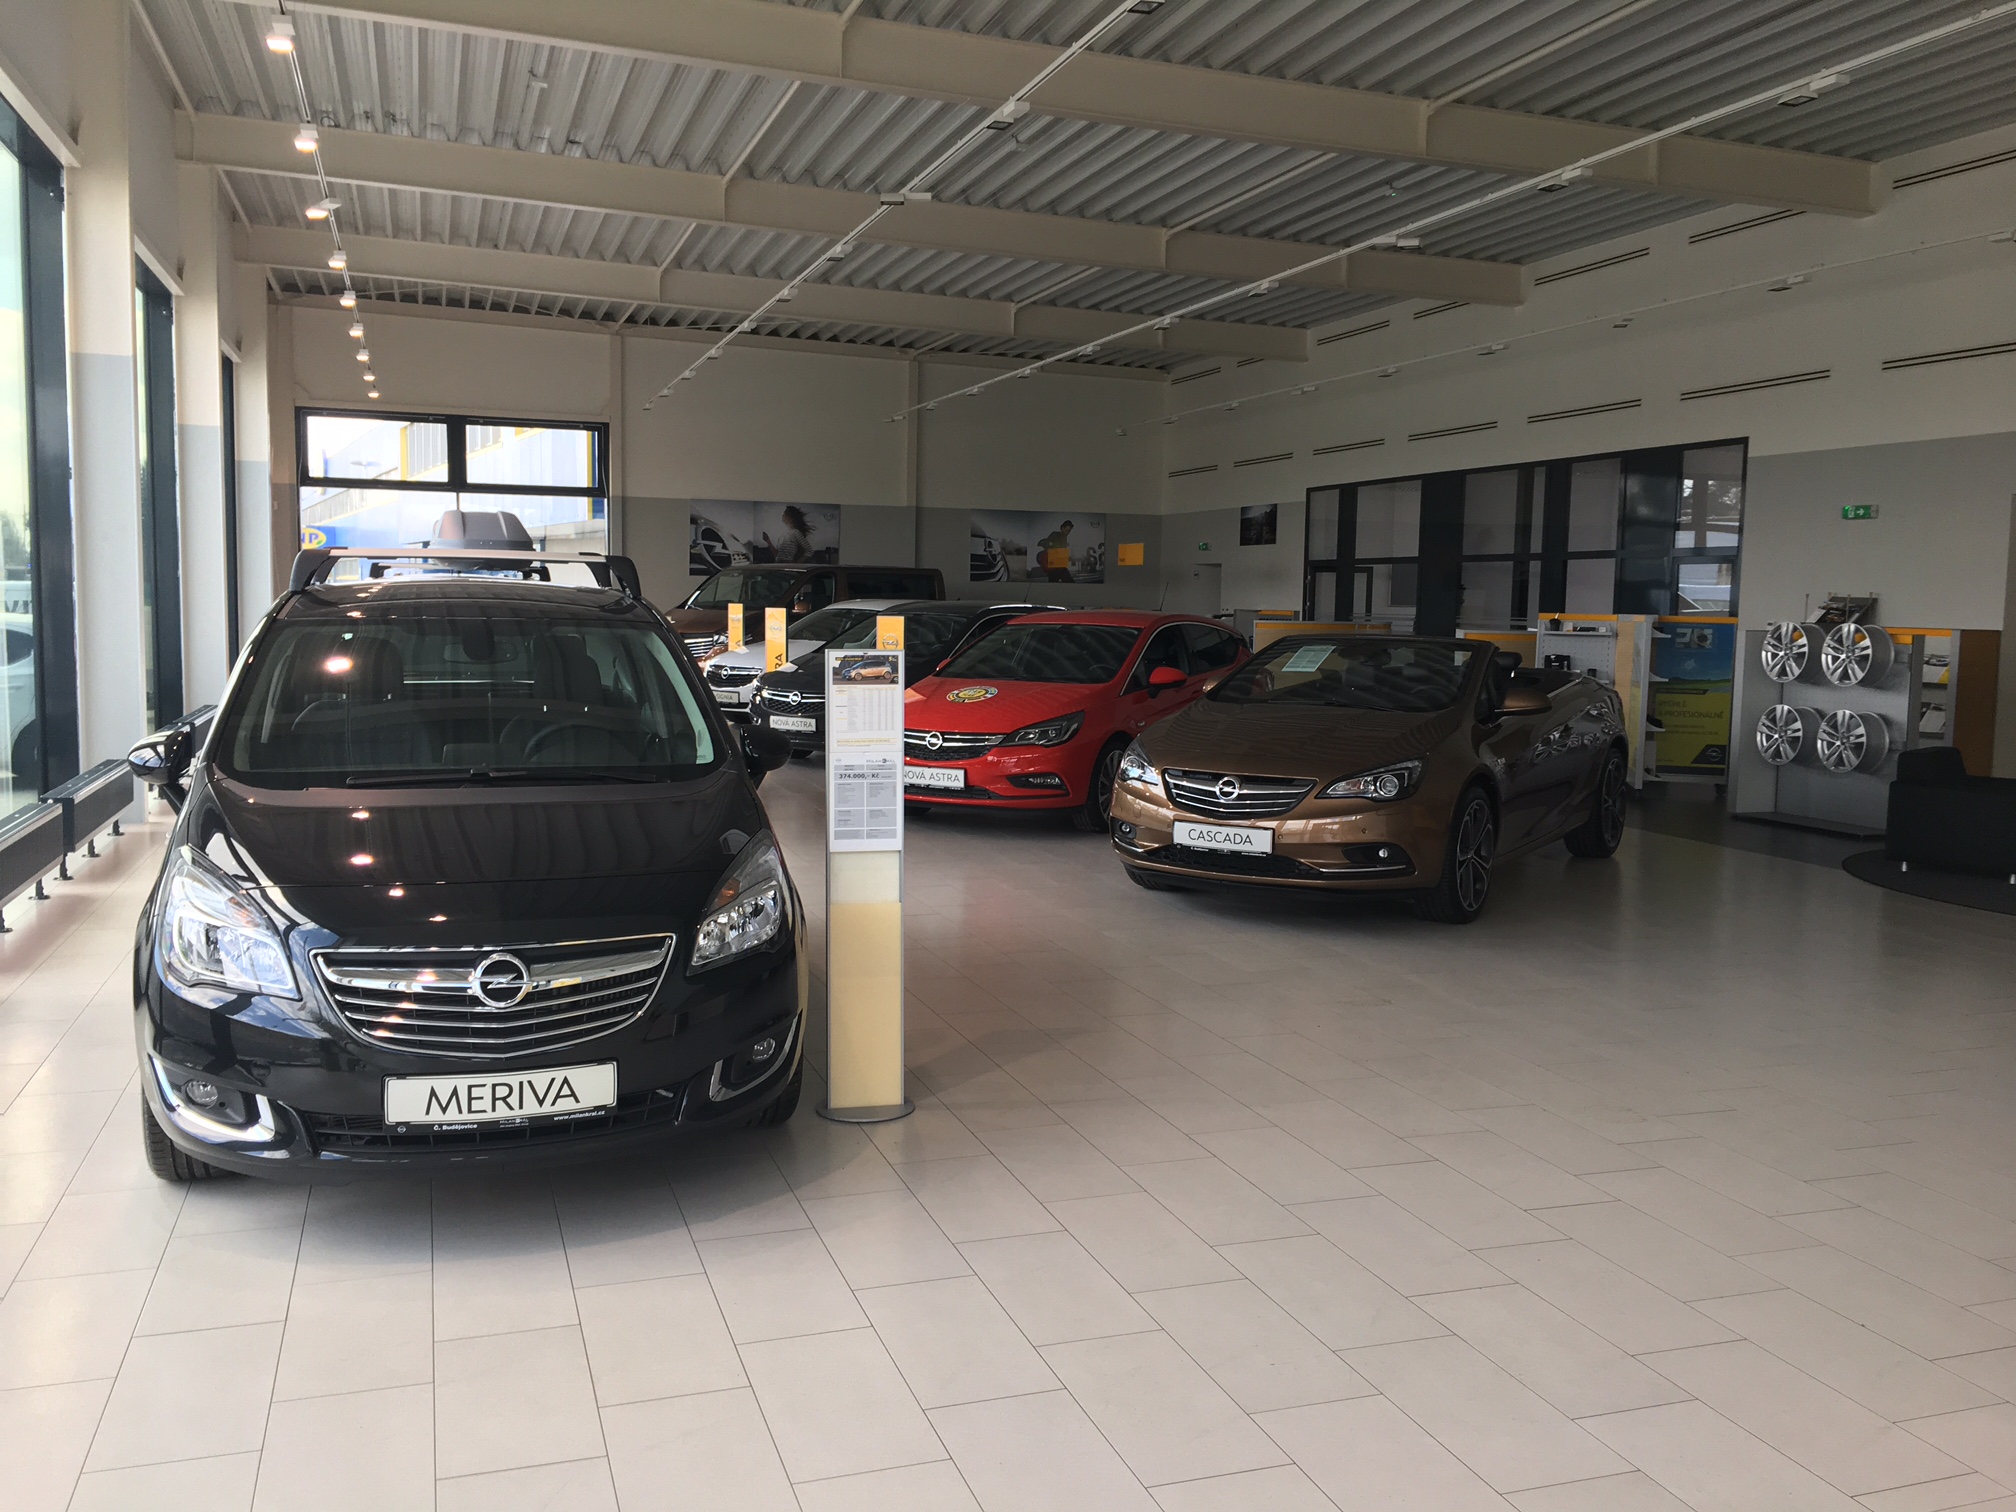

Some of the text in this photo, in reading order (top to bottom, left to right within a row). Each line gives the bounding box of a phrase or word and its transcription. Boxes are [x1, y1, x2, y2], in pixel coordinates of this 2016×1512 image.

[716, 693, 734, 701] SIGNIA
[772, 718, 813, 728] NOVÁ ASTRA
[929, 772, 960, 783] ASTRA
[1188, 828, 1253, 846] CASCADA
[424, 1075, 581, 1116] MERIVA
